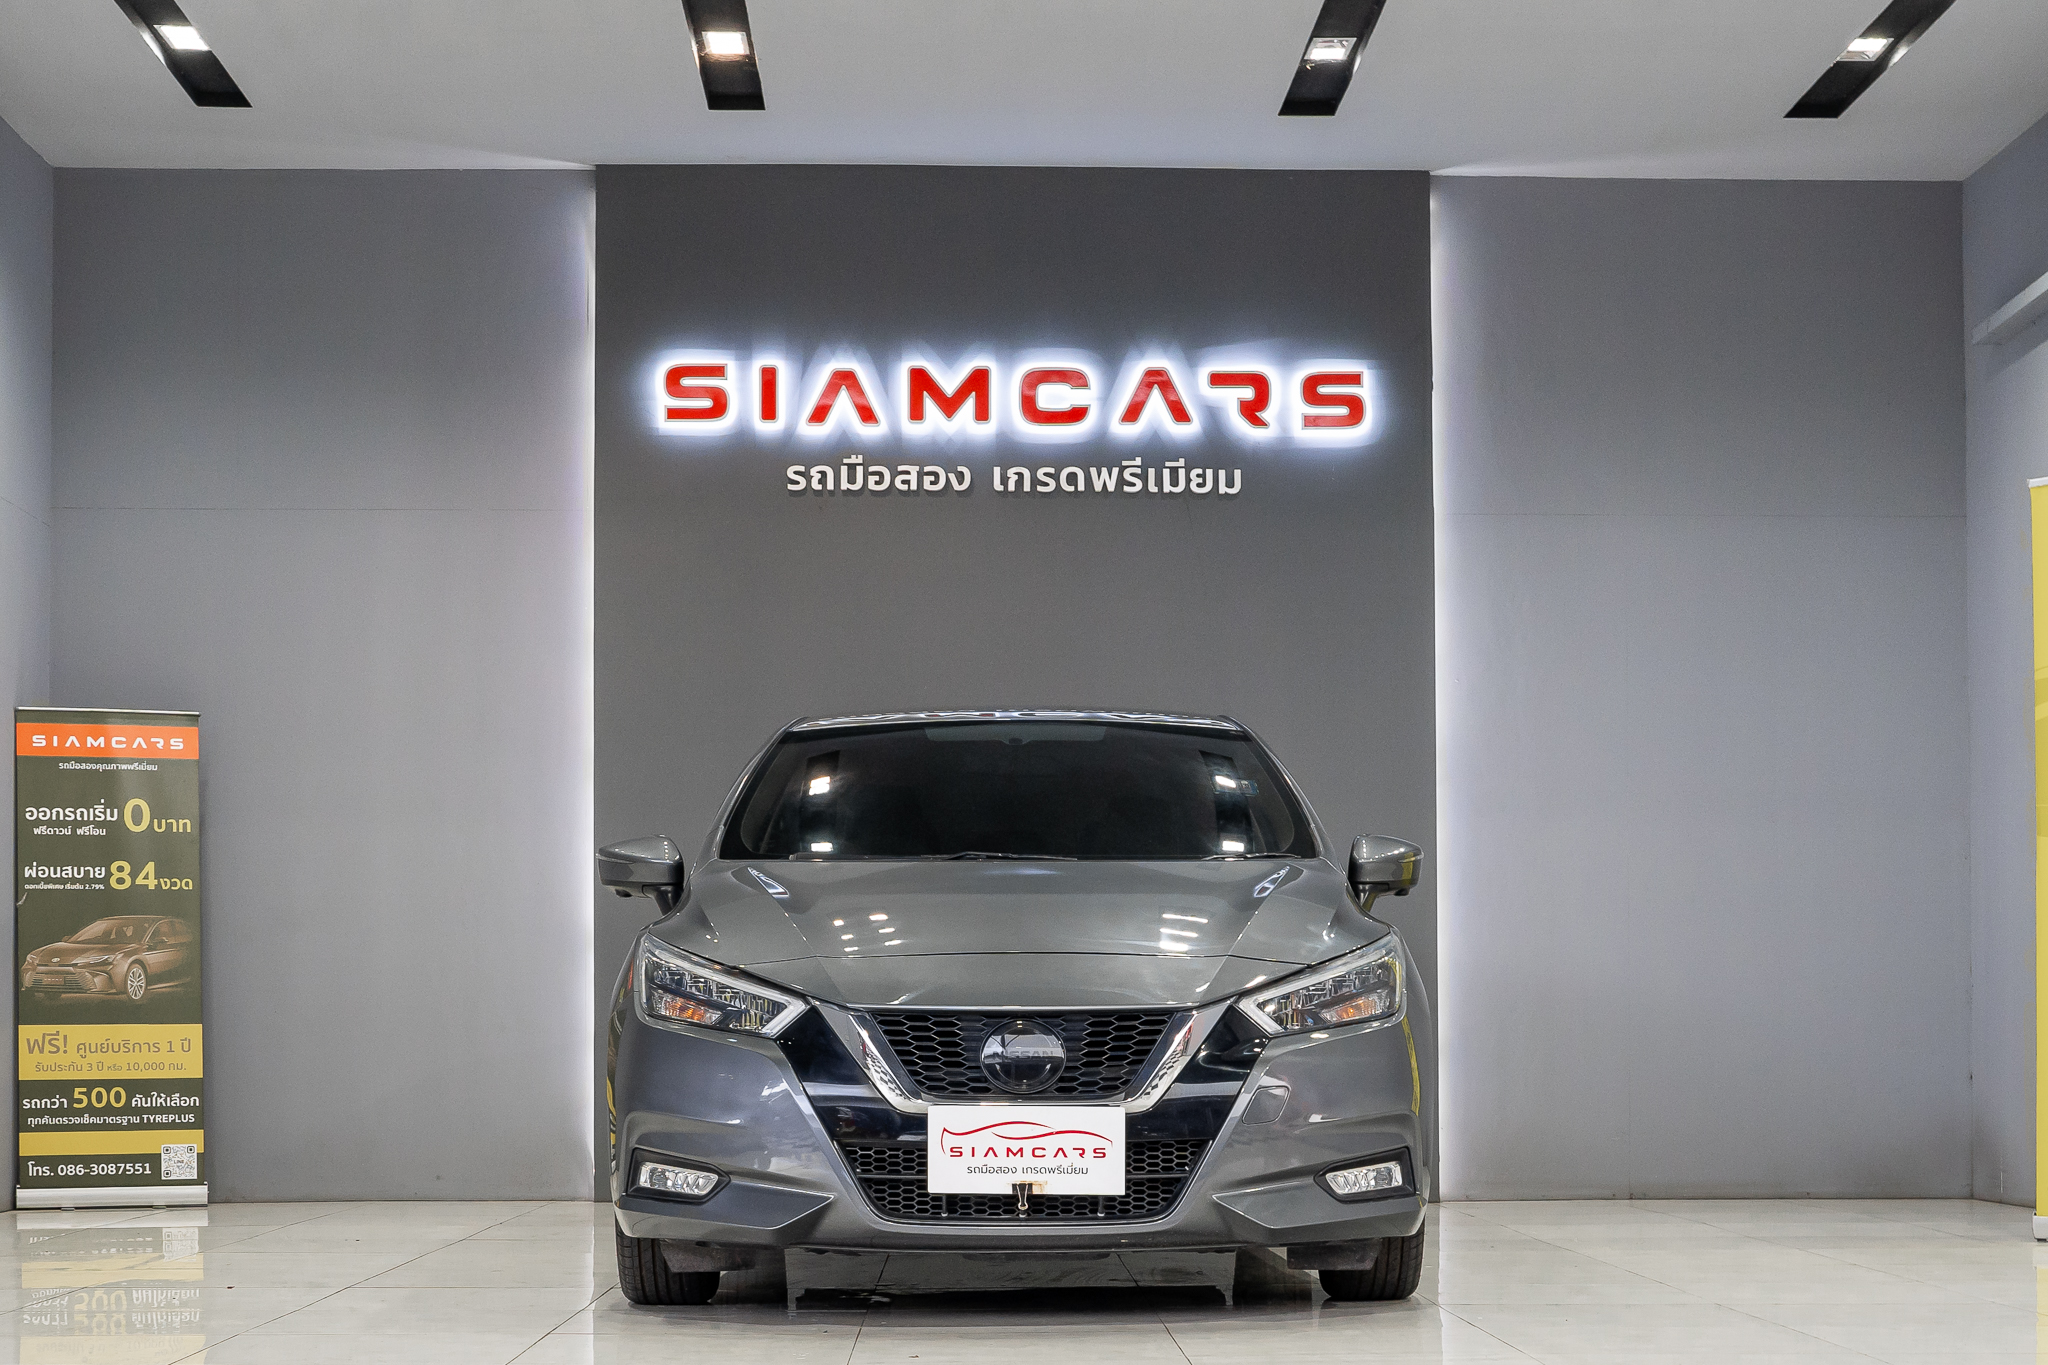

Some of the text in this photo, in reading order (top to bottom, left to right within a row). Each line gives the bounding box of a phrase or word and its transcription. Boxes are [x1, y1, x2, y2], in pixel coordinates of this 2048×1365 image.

[664, 363, 1365, 429] SIAMCARS
[787, 455, 1241, 494] รถมือสอง เกรดพรีเมียม
[32, 735, 184, 749] SIAMCARS
[25, 799, 118, 821] ออกรถเริ่ม
[34, 825, 105, 835] ฟรีดาวน์ ฟรีโอน
[25, 862, 105, 878] ผ่อนสบาย
[26, 1031, 190, 1058] ฟรี! ศูนย์บริการ 1 ปี
[35, 1061, 82, 1072] รับประกัน
[87, 1063, 92, 1071] 3
[96, 1061, 103, 1071] ปี
[127, 1062, 165, 1072] 10,000
[23, 1087, 199, 1108] รถกว่า 500 คันให้เลือก
[28, 1114, 195, 1127] ทุกคันตรวจเช็คมาตรฐาน TYREPLUS
[950, 1147, 1106, 1158] SIAMCARS
[28, 1161, 151, 1176] โทร. 086-3087551
[967, 1163, 1088, 1174] รถมือสอง เกรดพรีเมี่ยม
